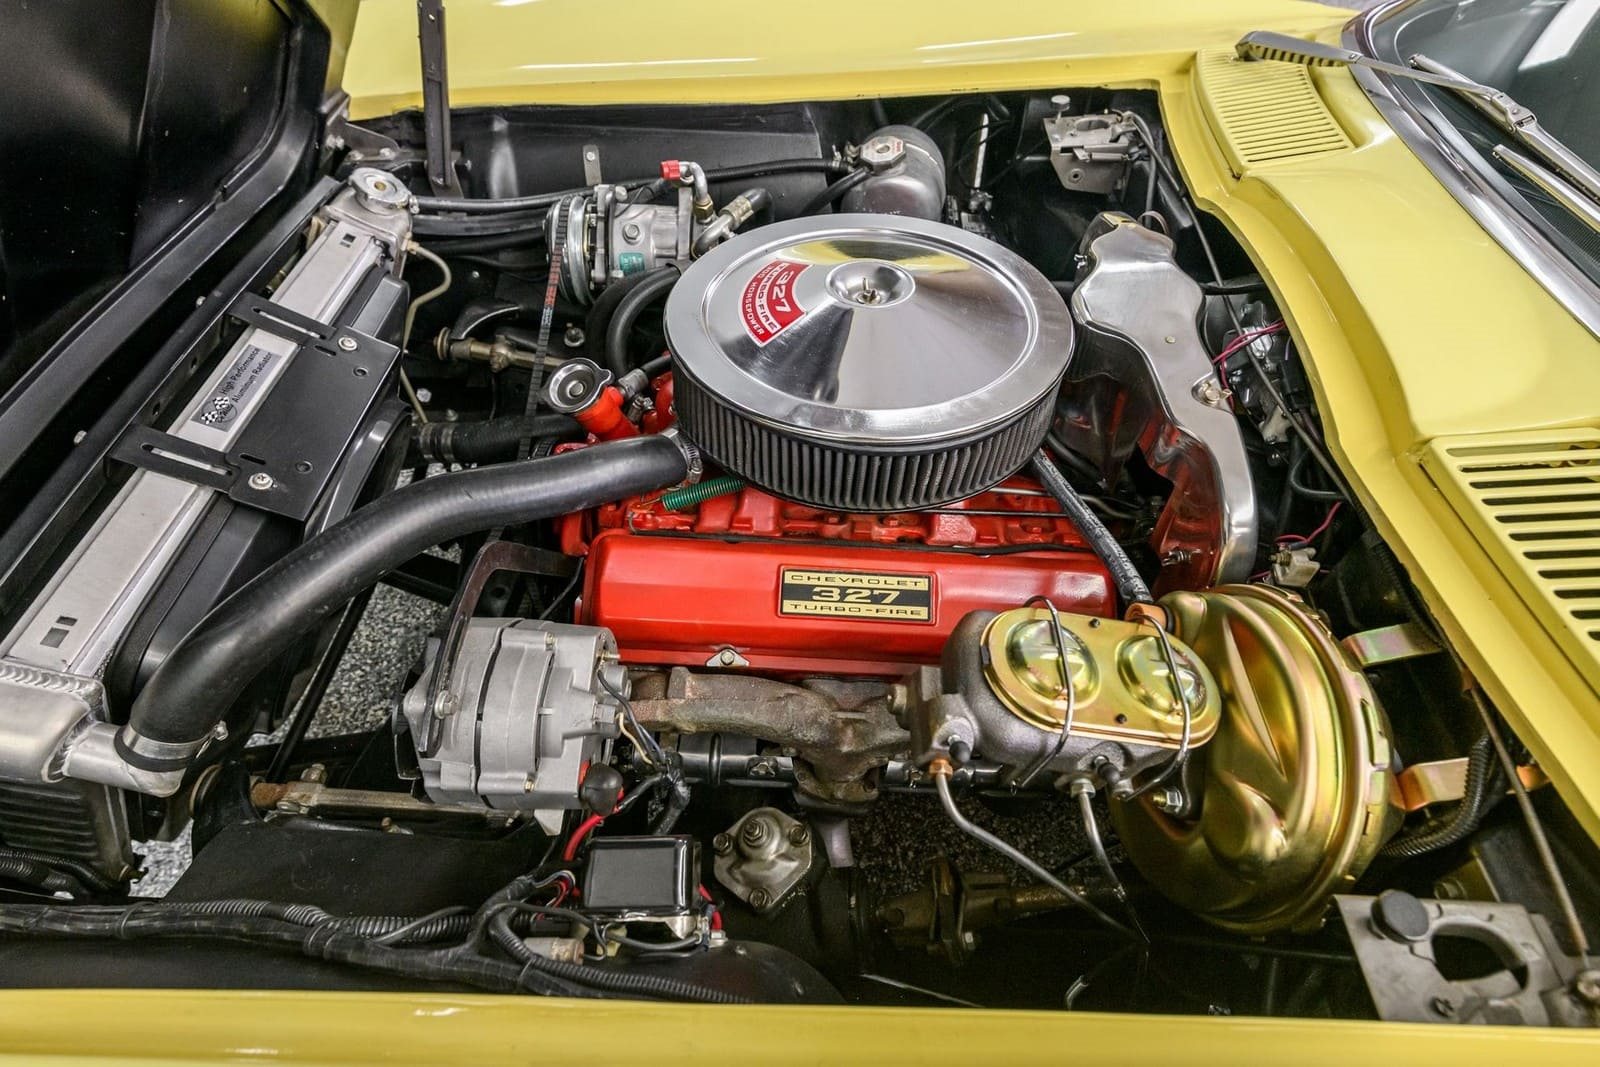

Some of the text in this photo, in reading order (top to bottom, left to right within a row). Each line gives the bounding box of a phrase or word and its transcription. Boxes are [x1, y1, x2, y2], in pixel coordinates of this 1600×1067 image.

[745, 281, 765, 335] HORSEPOWER
[758, 264, 784, 331] TURBO-FIRE
[772, 271, 794, 312] 327
[220, 381, 235, 395] High
[230, 348, 260, 380] Performance
[232, 352, 273, 403] Aluminum Radiator
[791, 574, 922, 587] CHEVROLET
[812, 586, 900, 604] 327
[790, 603, 922, 616] TURBO-FIRE
